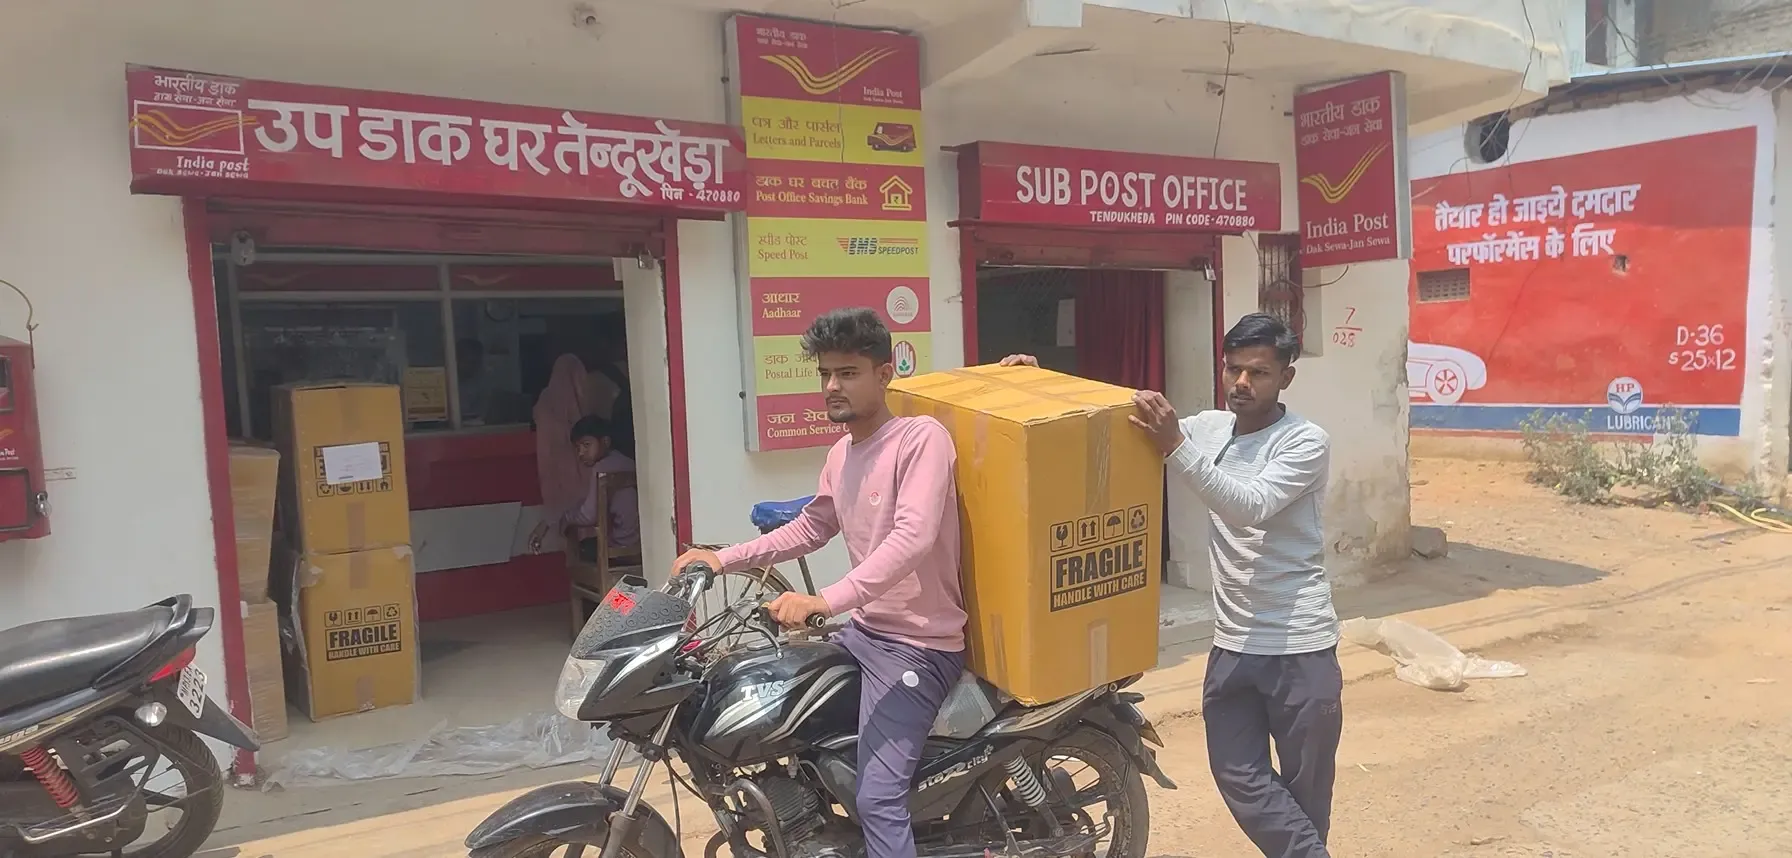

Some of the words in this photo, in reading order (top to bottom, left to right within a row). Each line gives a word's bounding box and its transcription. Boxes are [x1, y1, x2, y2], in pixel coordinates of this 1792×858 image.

[154, 73, 207, 94] भारतीय
[208, 81, 239, 96] डाक
[1300, 101, 1344, 128] भारतीय
[1350, 96, 1380, 116] डाक
[752, 117, 772, 129] पत्र
[778, 115, 799, 130] और
[248, 99, 349, 158] उप
[358, 107, 472, 165] डाक
[480, 119, 552, 176] घर
[753, 132, 787, 145] Letters
[789, 136, 807, 147] and
[808, 136, 841, 149] Parcels
[176, 155, 214, 169] India
[755, 175, 782, 187] डाक
[788, 177, 805, 188] घर
[811, 178, 840, 189] बचत
[1016, 165, 1071, 205] SUB
[1080, 169, 1156, 208] POST
[1163, 174, 1248, 211] OFFICE
[660, 182, 684, 200] पिन
[695, 189, 740, 202] 470880
[756, 190, 776, 202] Post
[778, 191, 806, 203] Office
[808, 192, 843, 206] Savings
[845, 193, 868, 205] Bank
[1435, 200, 1484, 231] तैयार
[1487, 194, 1509, 226] हो
[1513, 185, 1567, 224] जाइये
[1572, 183, 1642, 219] दमदार
[1090, 211, 1155, 225] TENDUKHEDA
[1165, 213, 1182, 225] PIN
[1306, 217, 1348, 240] India
[1353, 212, 1389, 233] Post
[759, 232, 781, 246] स्पीड
[1306, 243, 1323, 254] Dak
[1367, 236, 1390, 247] Sewa
[1545, 226, 1566, 259] के
[1572, 222, 1616, 257] लिए
[758, 249, 786, 262] Speed
[789, 249, 808, 260] Post
[878, 246, 919, 255] SPEEDPOST
[762, 292, 800, 304] आधार
[762, 307, 801, 319] Aadhaar
[763, 354, 789, 365] डाक
[765, 368, 792, 379] Postal
[795, 367, 813, 378] Life
[1615, 383, 1635, 393] HP
[766, 413, 796, 424] जन
[767, 427, 807, 438] Common
[809, 424, 841, 435] Service
[1056, 540, 1143, 589] FRAGILE
[1053, 585, 1092, 608] HANDLE
[1094, 581, 1119, 598] WITH
[1121, 572, 1145, 590] CARE
[329, 624, 397, 648] FRAGILE
[328, 648, 358, 659] HANDLE
[358, 645, 379, 656] WITH
[380, 642, 400, 652] CARE
[740, 680, 785, 701] TVS
